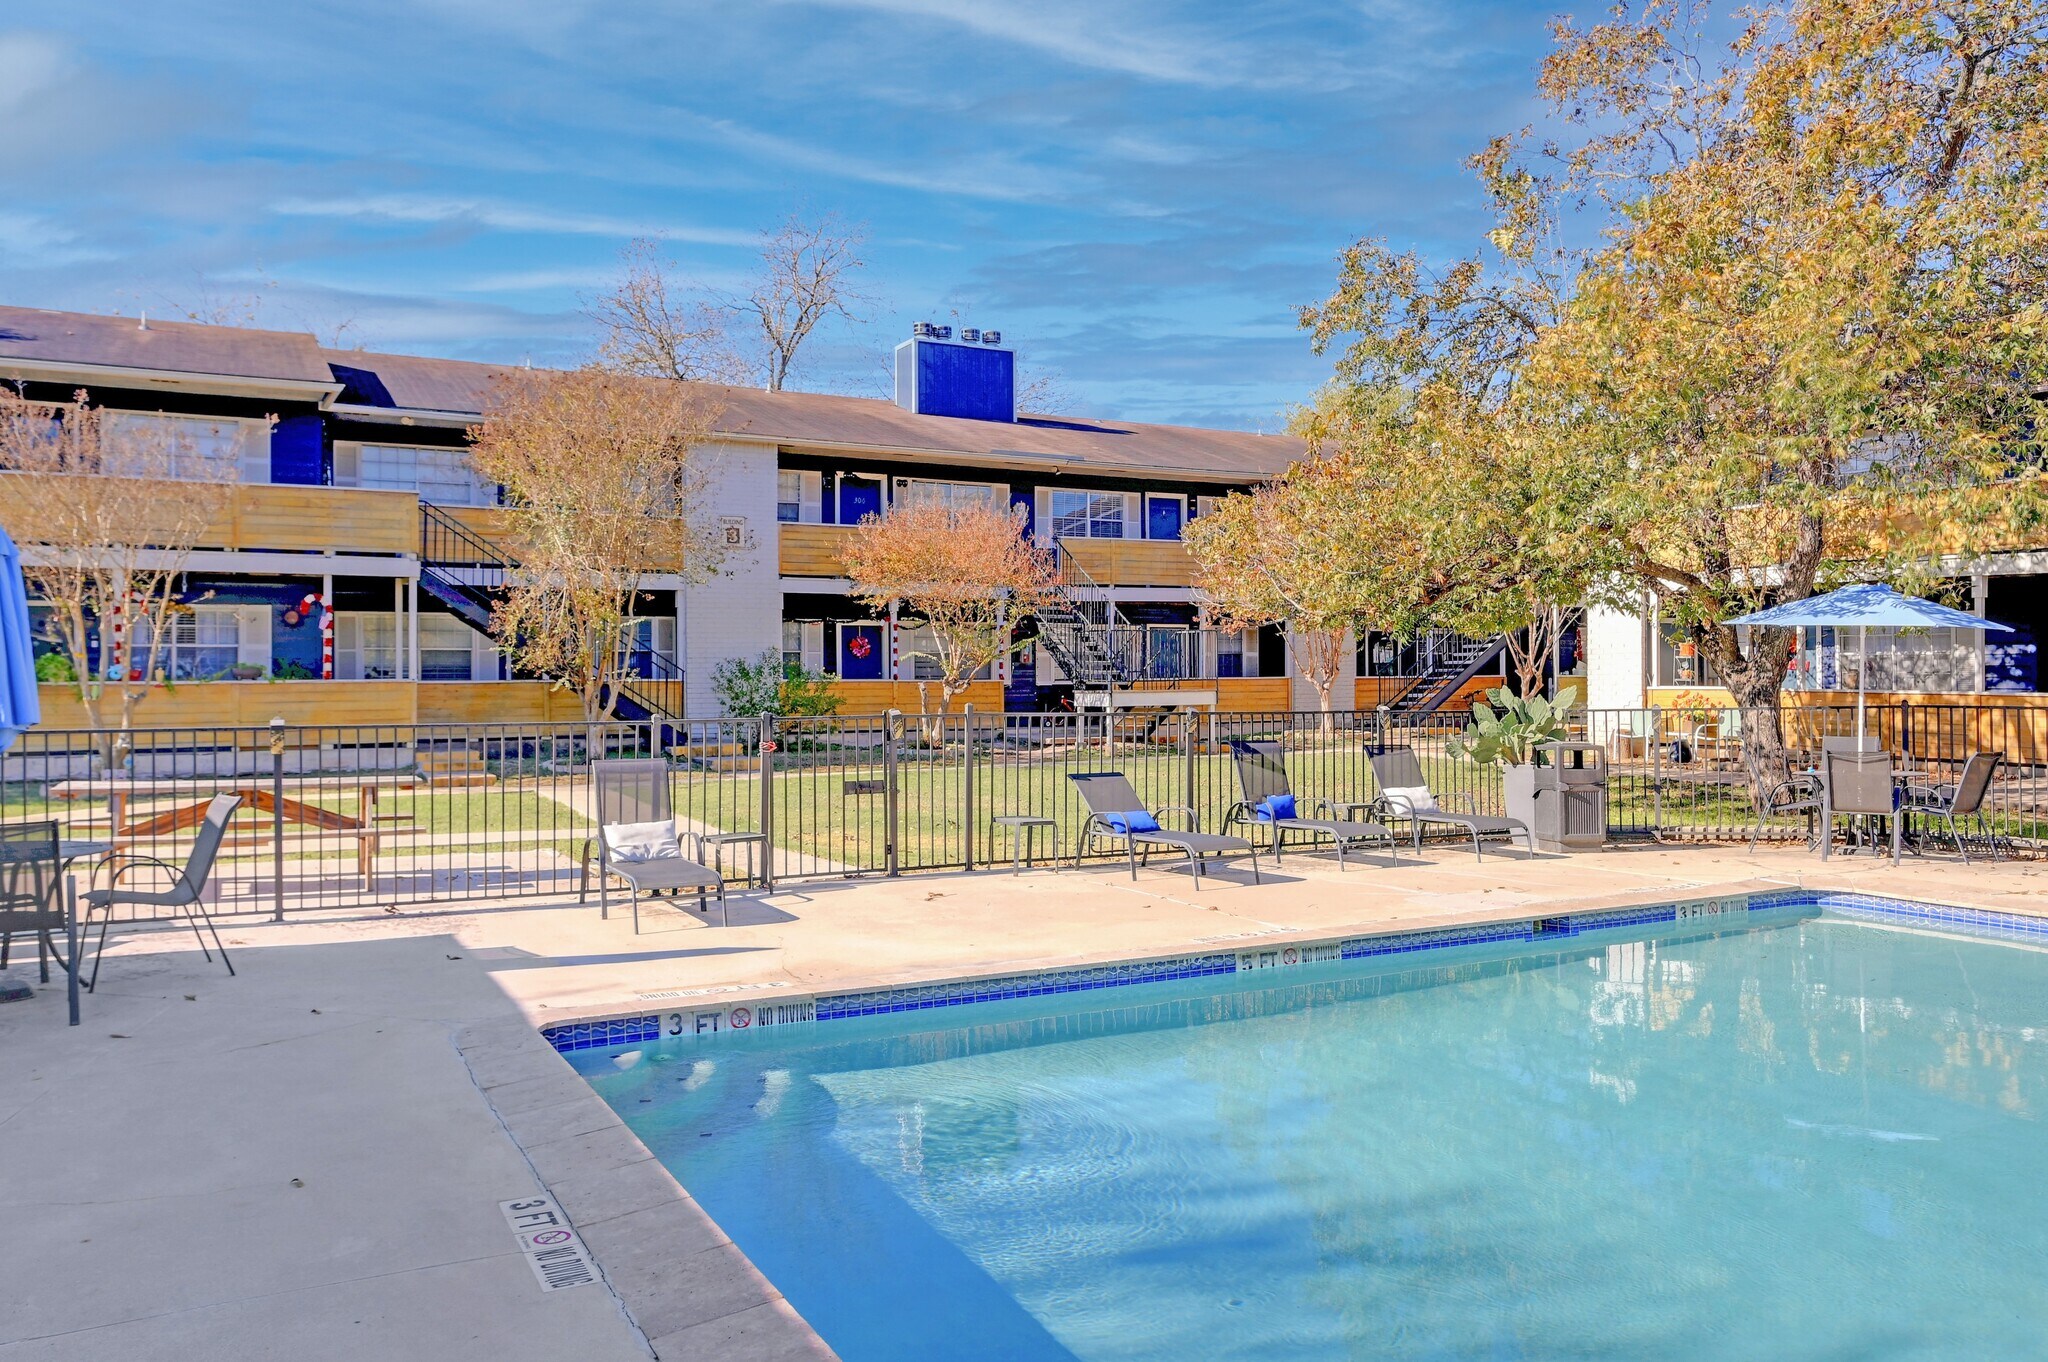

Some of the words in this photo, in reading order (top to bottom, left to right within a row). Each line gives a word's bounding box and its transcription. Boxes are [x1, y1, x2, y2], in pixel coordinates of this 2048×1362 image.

[728, 529, 739, 543] 3
[1680, 906, 1687, 919] 3
[1692, 904, 1704, 918] FT
[1259, 951, 1278, 969] FT
[1302, 948, 1313, 964] NO
[1315, 944, 1341, 962] DIVING
[668, 1013, 683, 1036] 3
[696, 1012, 722, 1034] FT
[758, 1007, 773, 1027] NO
[778, 1002, 814, 1025] DIVING
[509, 1200, 546, 1210] 3
[514, 1211, 559, 1228] FT
[533, 1246, 577, 1261] NO
[540, 1258, 593, 1288] DIVING
